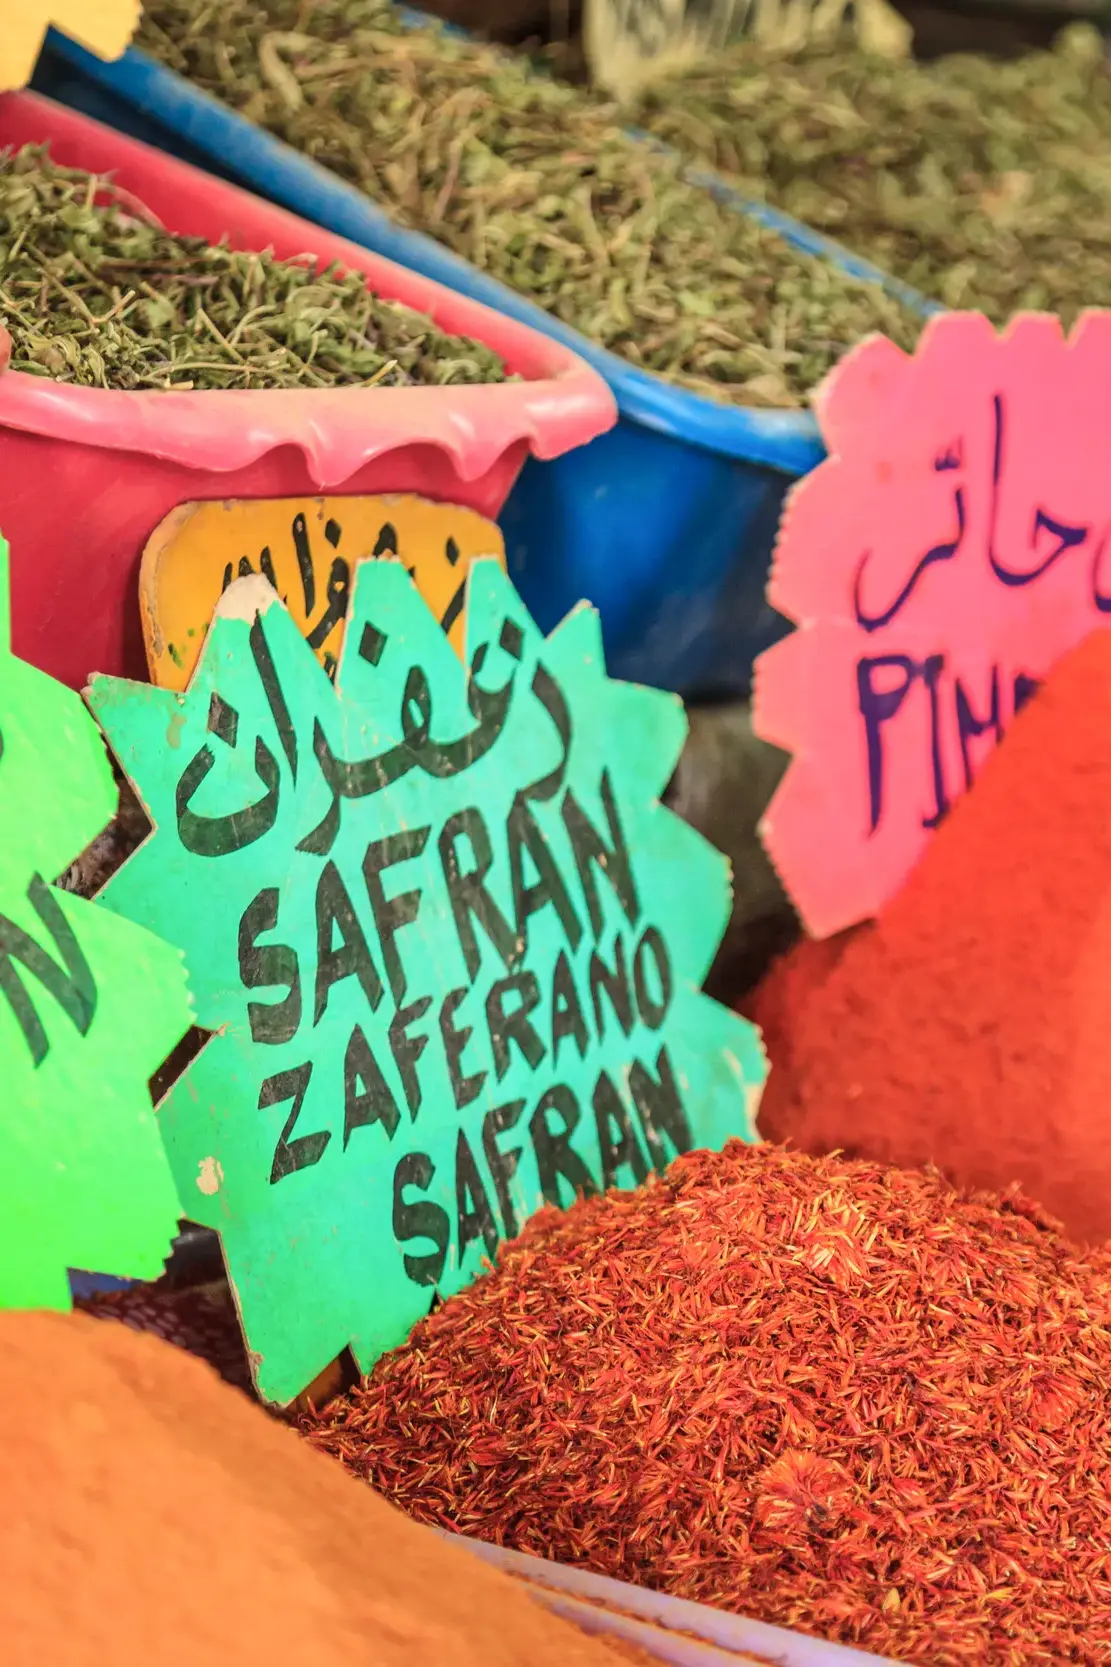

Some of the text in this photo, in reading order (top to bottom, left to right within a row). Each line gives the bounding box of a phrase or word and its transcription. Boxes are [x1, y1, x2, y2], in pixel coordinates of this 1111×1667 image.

[175, 608, 572, 857] زعفران
[238, 766, 642, 1045] SAFRAN
[257, 925, 674, 1185] ZAFERANO
[391, 1042, 694, 1288] SAFRAN
